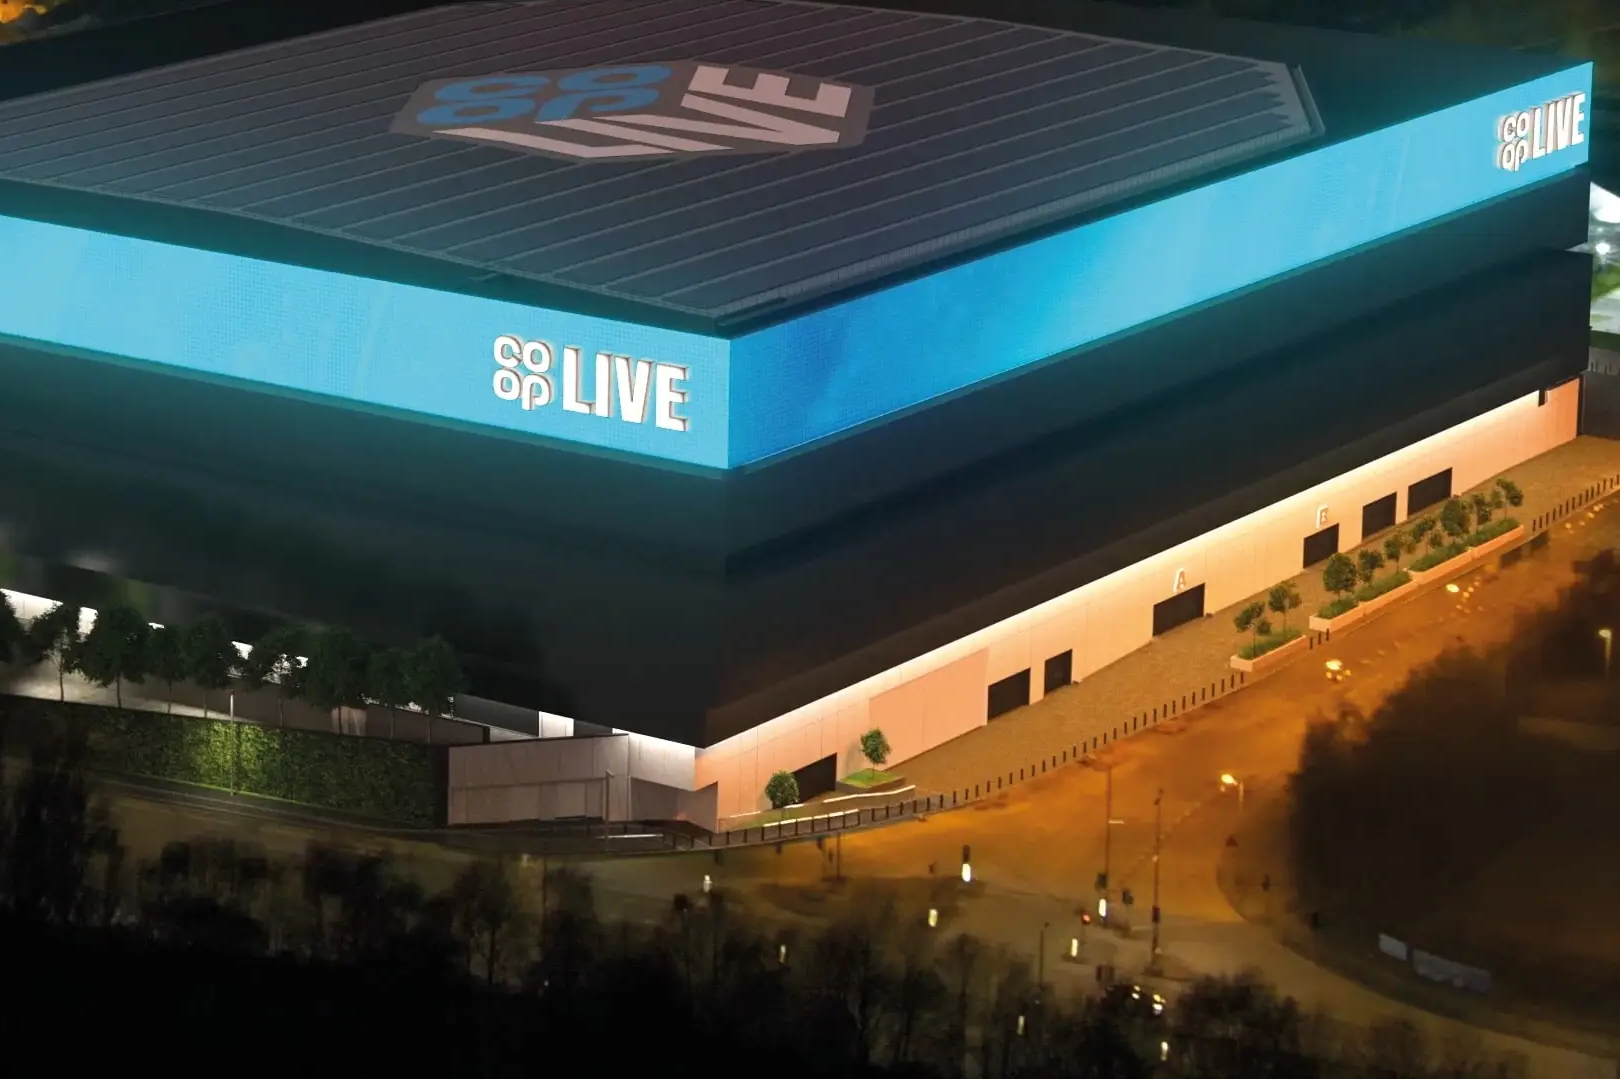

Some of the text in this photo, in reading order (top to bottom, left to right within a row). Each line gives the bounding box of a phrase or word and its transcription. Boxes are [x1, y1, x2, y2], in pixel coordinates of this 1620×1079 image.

[432, 65, 851, 158] LIVE
[1530, 91, 1586, 160] LIVE
[562, 345, 688, 432] LIVE
